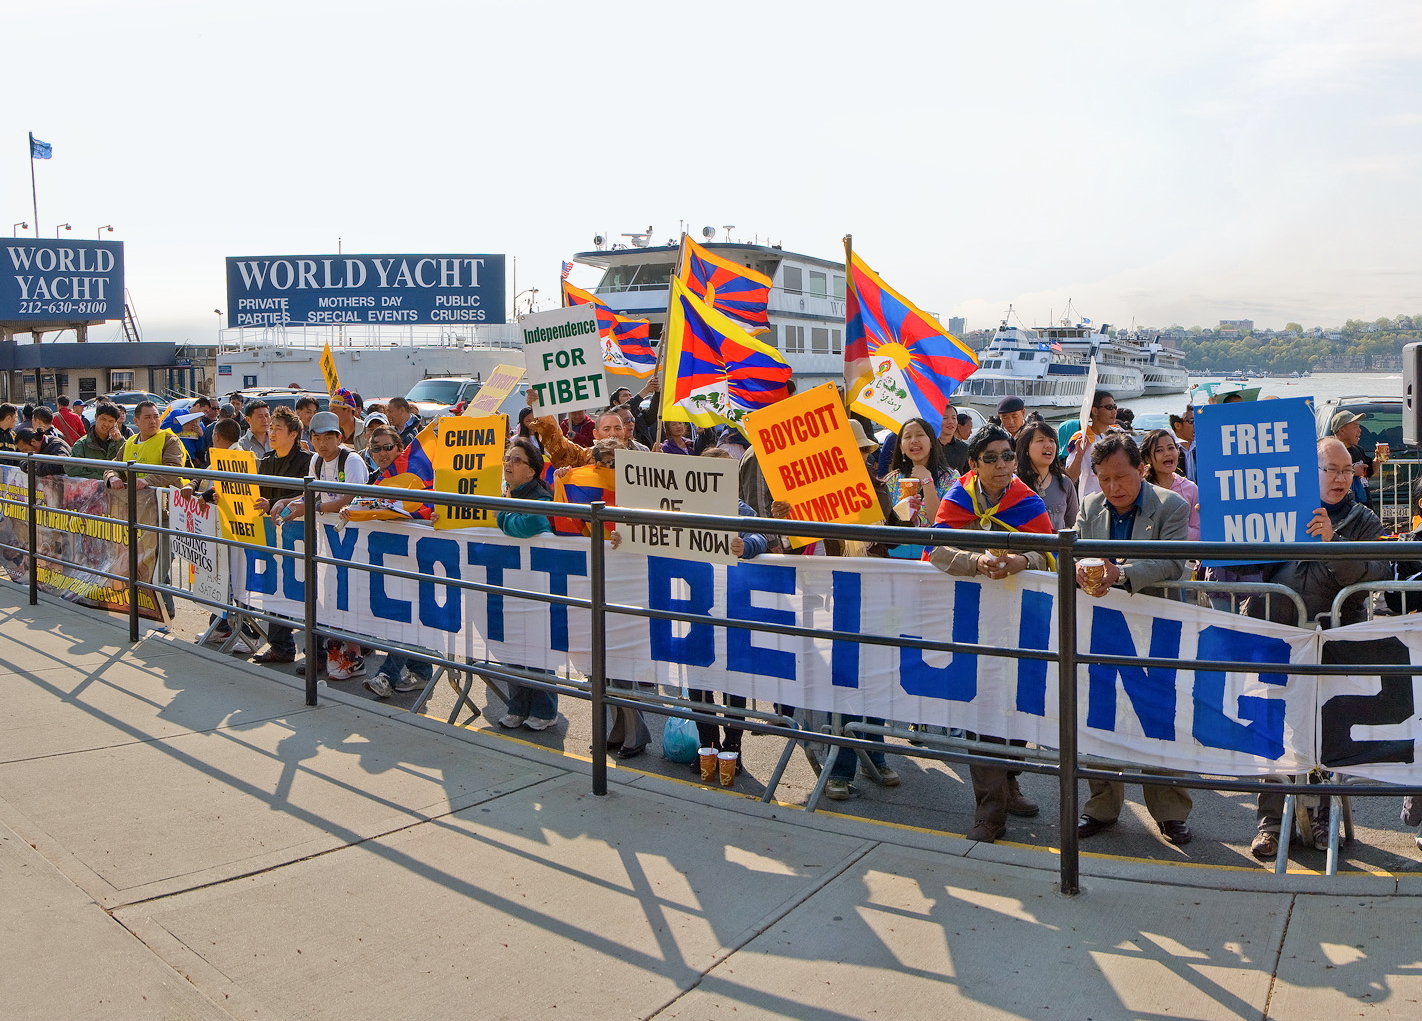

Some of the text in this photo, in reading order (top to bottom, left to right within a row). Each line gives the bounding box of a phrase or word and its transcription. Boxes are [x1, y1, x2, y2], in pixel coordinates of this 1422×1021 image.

[7, 247, 115, 272] WORLD
[237, 258, 485, 290] WORLD YACHT
[14, 275, 110, 300] YACHT
[18, 301, 107, 314] 212-630-8100
[238, 298, 289, 309] PRIVATE
[318, 297, 403, 308] MOTHERS DAY
[435, 295, 480, 306] PUBLIC
[238, 313, 291, 324] PARTIES
[307, 310, 418, 322] SPECIAL EVENTS
[430, 310, 486, 321] CRUISES
[523, 319, 596, 345] Independence
[542, 347, 586, 371] FOR
[532, 373, 603, 407] TIBET
[445, 428, 496, 447] CHINA
[758, 403, 839, 455] BOYCOTT
[1220, 421, 1290, 456] FREE
[216, 460, 248, 474] ALLOW
[453, 453, 486, 471] OUT
[778, 446, 848, 491] BEIJING
[221, 481, 252, 497] MEDIA
[458, 478, 478, 495] OF
[624, 464, 724, 493] CHINA OUT
[1214, 466, 1300, 501] TIBET
[234, 501, 245, 516] IN
[229, 520, 255, 537] TIBET
[1223, 511, 1297, 542] NOW
[626, 523, 730, 556] TIBET NOW
[173, 539, 213, 573] OLYMPICS
[124, 588, 155, 610] Cina
[245, 516, 587, 652] BOYCOTT
[647, 555, 1291, 760] BEIJING
